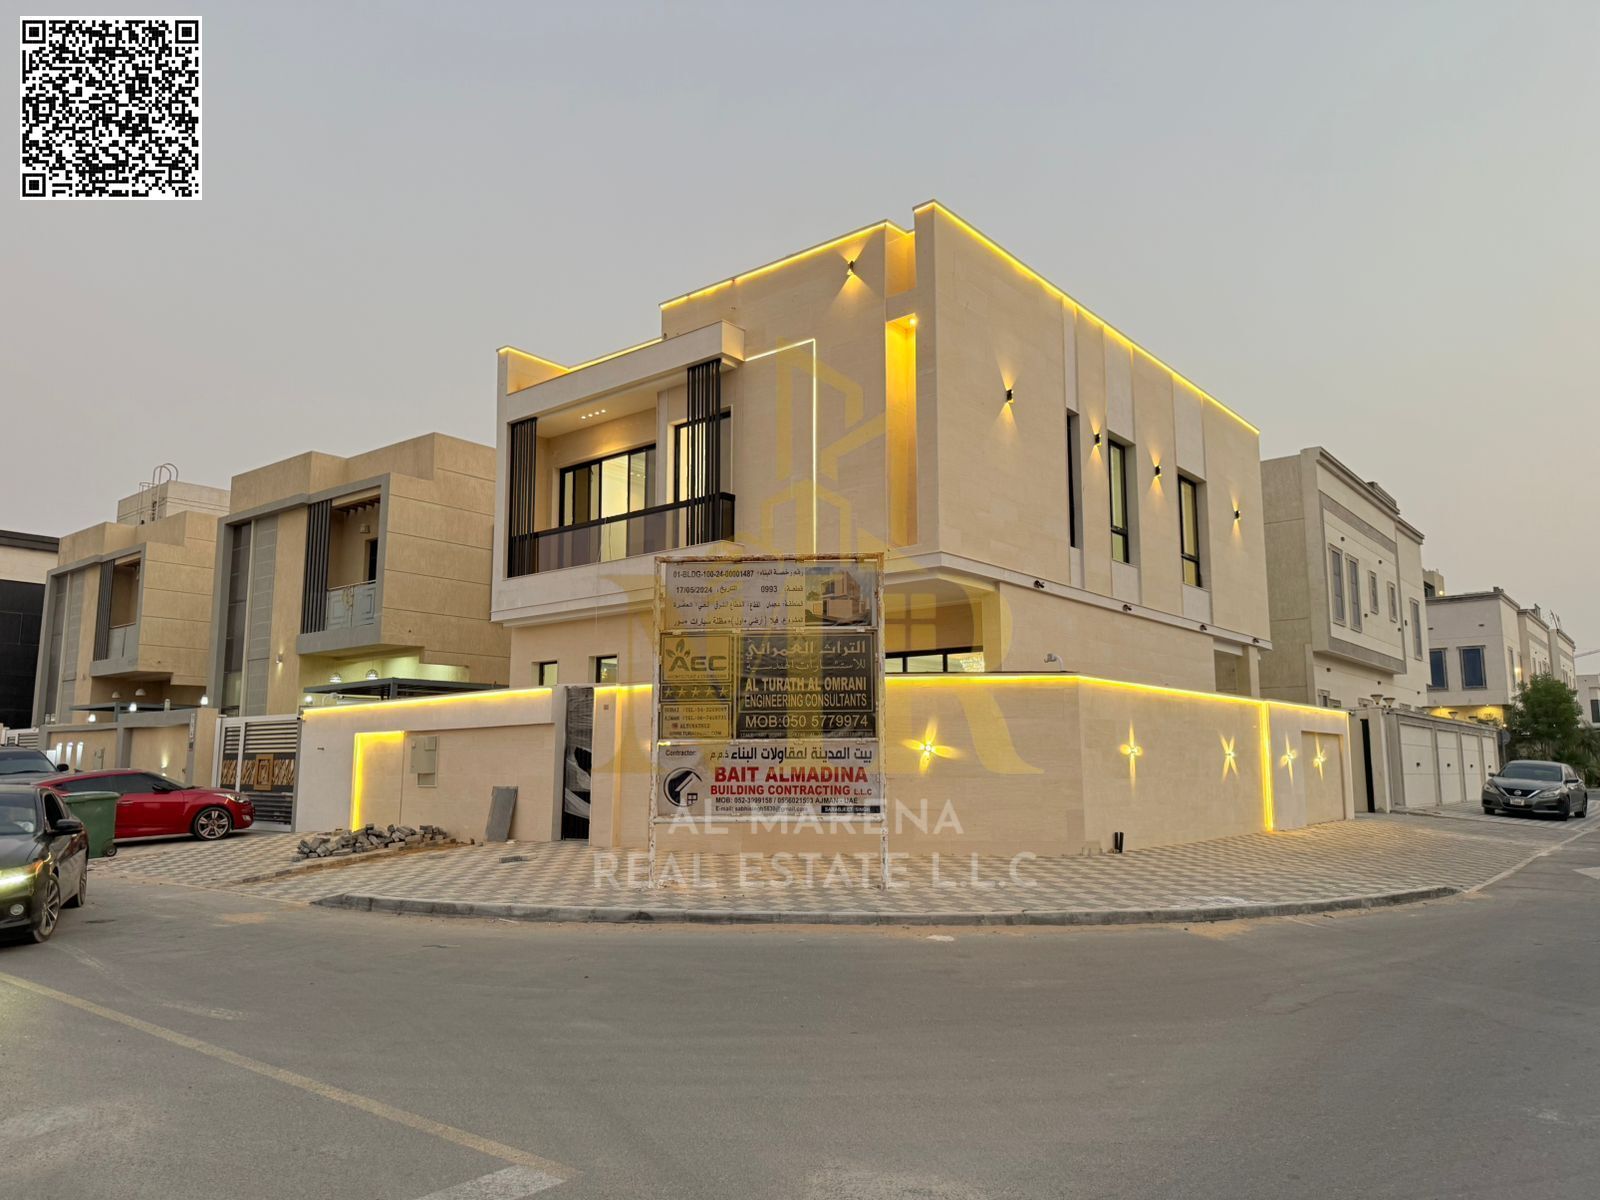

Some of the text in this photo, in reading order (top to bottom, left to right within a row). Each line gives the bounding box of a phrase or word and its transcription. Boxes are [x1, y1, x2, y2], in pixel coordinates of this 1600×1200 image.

[820, 640, 866, 656] التراث
[668, 656, 727, 672] AEC
[745, 676, 866, 692] AL TURATH AL OMRANI
[744, 694, 866, 707] ENGINEERING CONSULTANTS
[746, 714, 868, 728] MOB:050 5779974
[730, 747, 756, 762] البناء
[761, 747, 807, 764] لمقاولات
[811, 746, 850, 764] المدينة
[854, 748, 872, 763] بيت
[714, 766, 868, 782] BAIT ALMADINA
[710, 785, 766, 795] BUILDING
[768, 784, 850, 795] CONTRACTING
